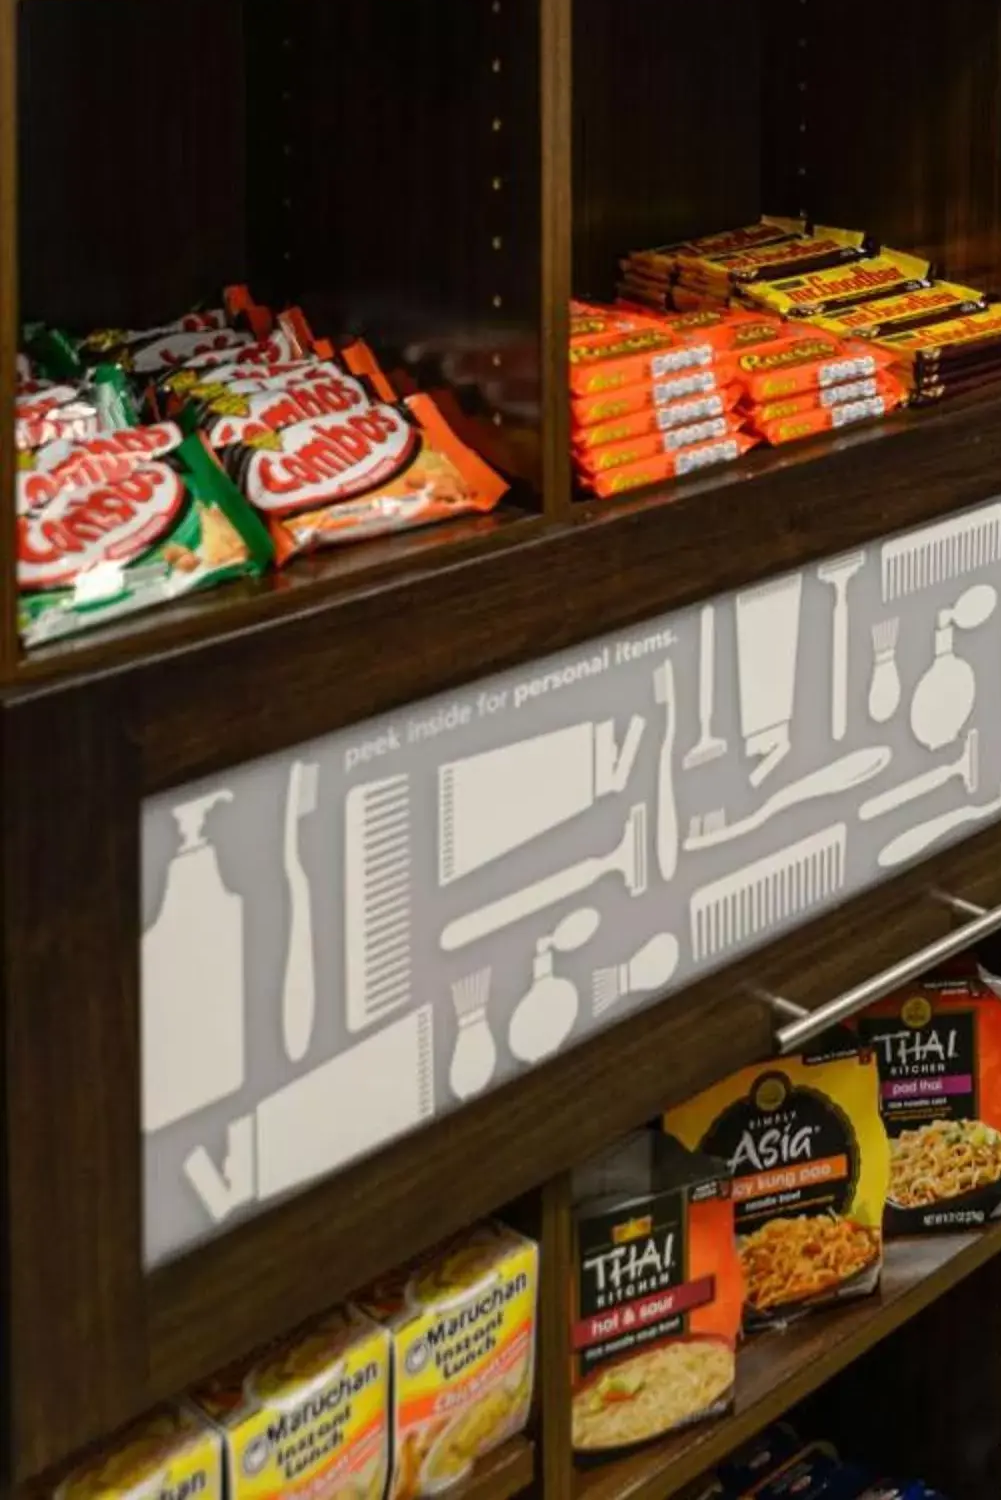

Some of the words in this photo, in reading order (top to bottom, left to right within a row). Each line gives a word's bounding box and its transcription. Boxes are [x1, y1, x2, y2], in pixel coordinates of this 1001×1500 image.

[257, 407, 399, 494] Combos
[344, 725, 401, 774] peek
[407, 704, 472, 744] inside
[476, 690, 509, 717] for
[513, 649, 609, 708] personal
[614, 628, 679, 666] items.
[873, 1029, 957, 1064] THAI
[891, 1063, 945, 1076] KITCHEN
[727, 1124, 813, 1175] Asia
[583, 1232, 674, 1291] THAI
[426, 1271, 528, 1349] Maruchan
[441, 1334, 499, 1381] Lunch
[266, 1360, 379, 1444] Maruchan
[284, 1431, 346, 1480] Lunch
